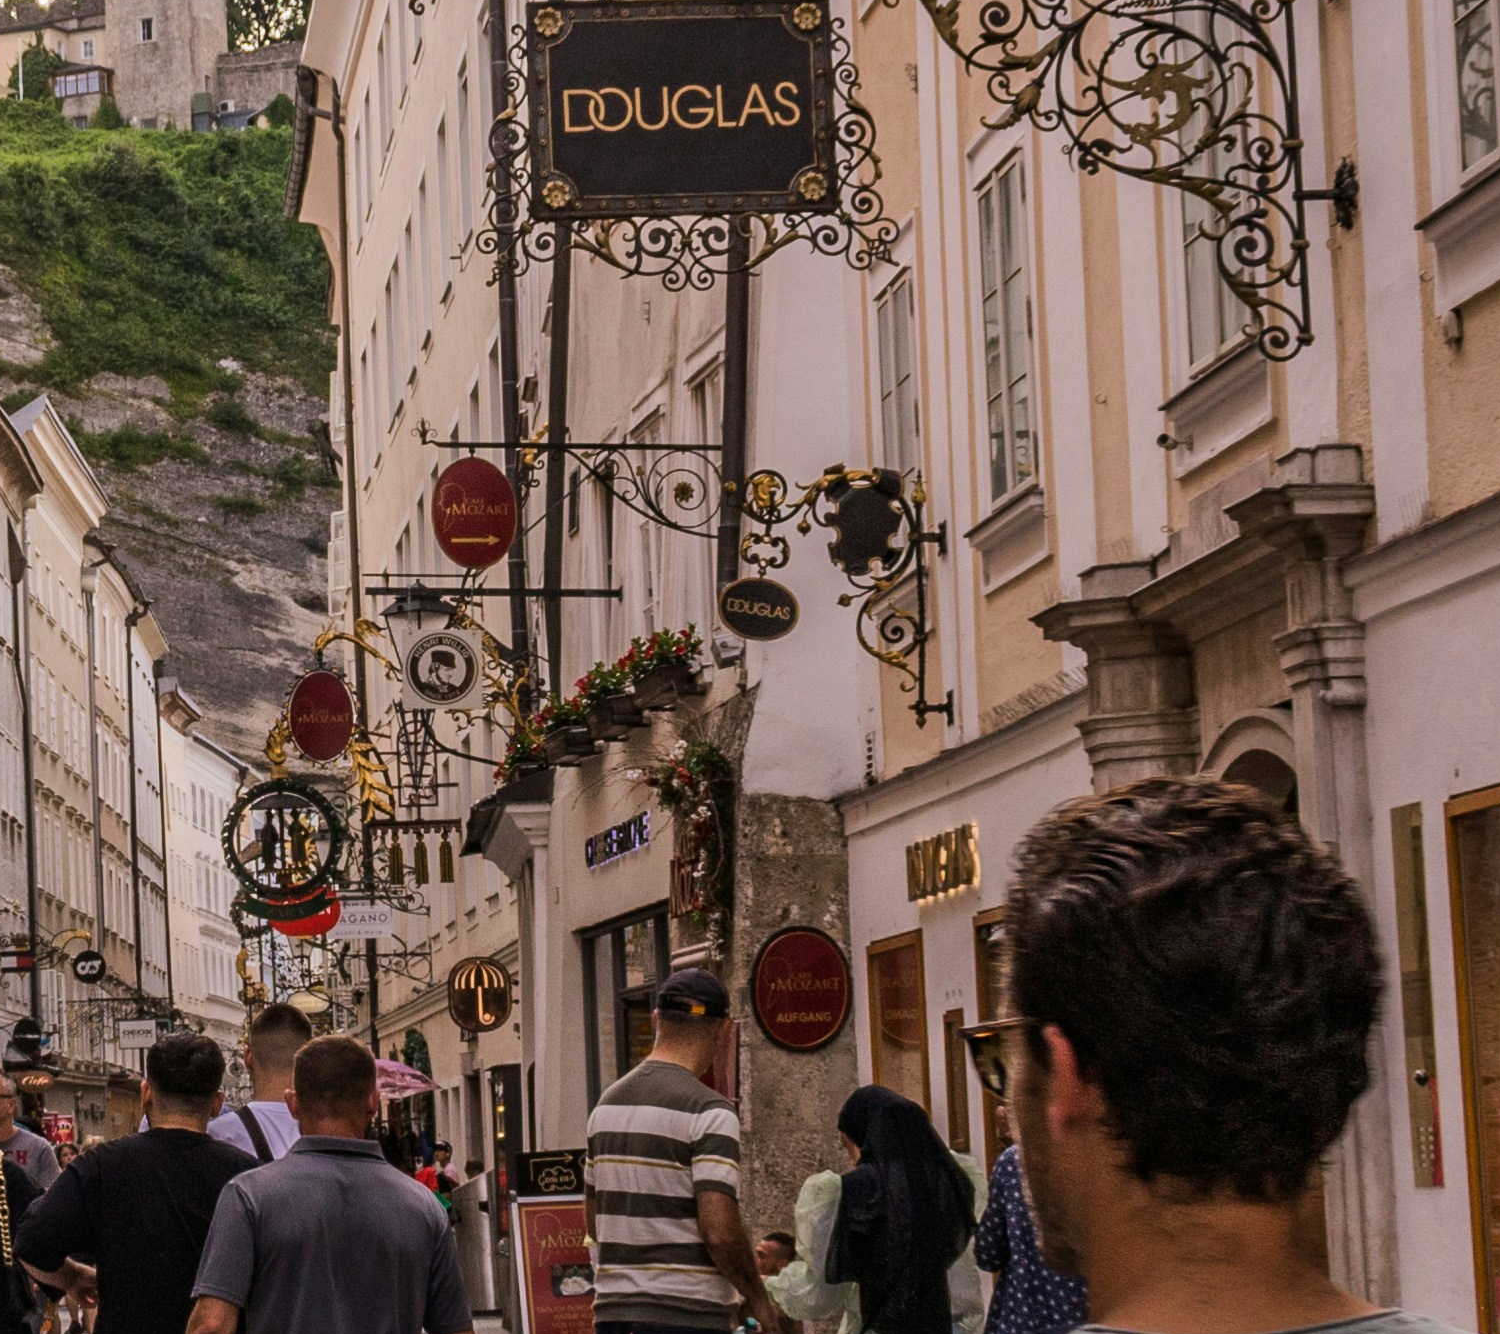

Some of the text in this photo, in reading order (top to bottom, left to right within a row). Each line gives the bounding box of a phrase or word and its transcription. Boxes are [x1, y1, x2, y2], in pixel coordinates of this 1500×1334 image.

[562, 81, 800, 133] DOUGLAS
[451, 502, 511, 515] MOZART
[726, 597, 791, 621] DOUGLAS
[340, 913, 388, 924] AGANO
[777, 977, 840, 991] MOZART
[776, 1011, 832, 1024] AUFGANG
